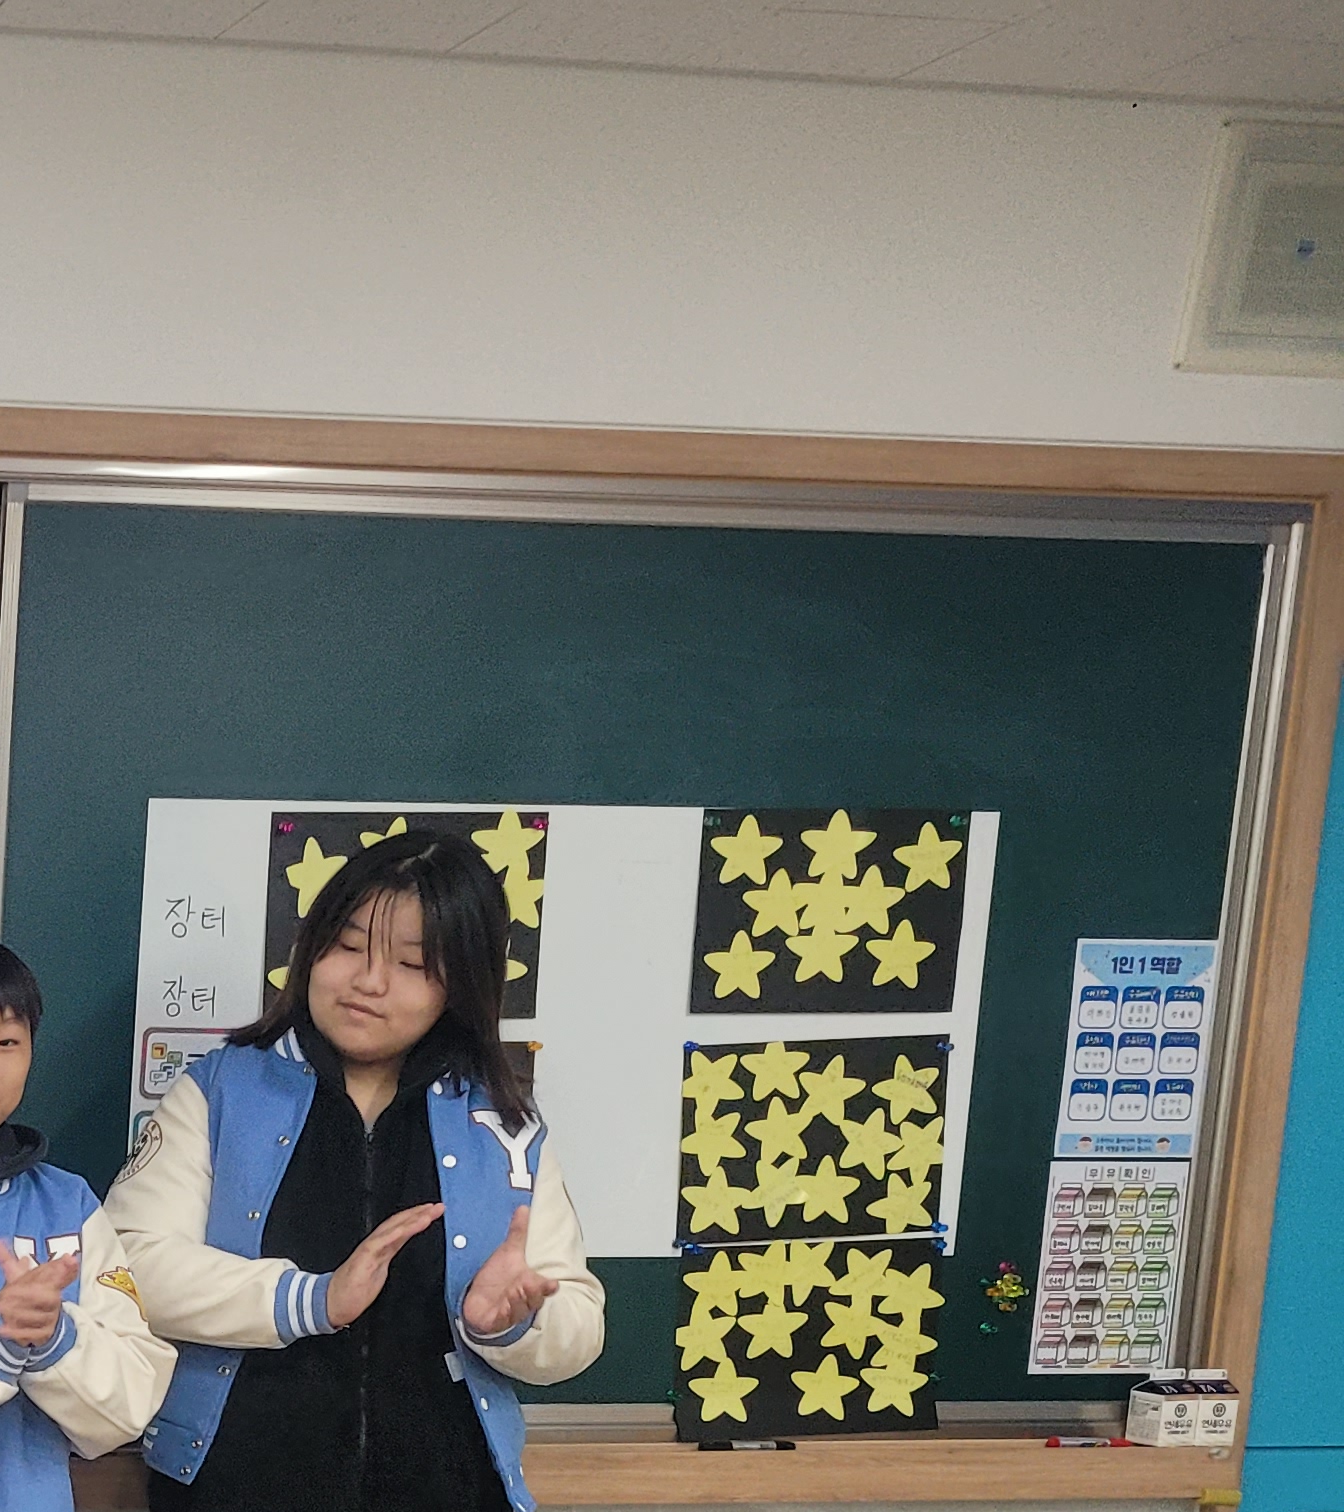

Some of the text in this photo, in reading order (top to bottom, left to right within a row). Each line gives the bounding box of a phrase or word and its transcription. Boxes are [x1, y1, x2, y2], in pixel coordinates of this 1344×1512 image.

[165, 896, 226, 938] 장터
[1111, 956, 1182, 974] 1인 1 역할
[162, 976, 217, 1018] 장터
